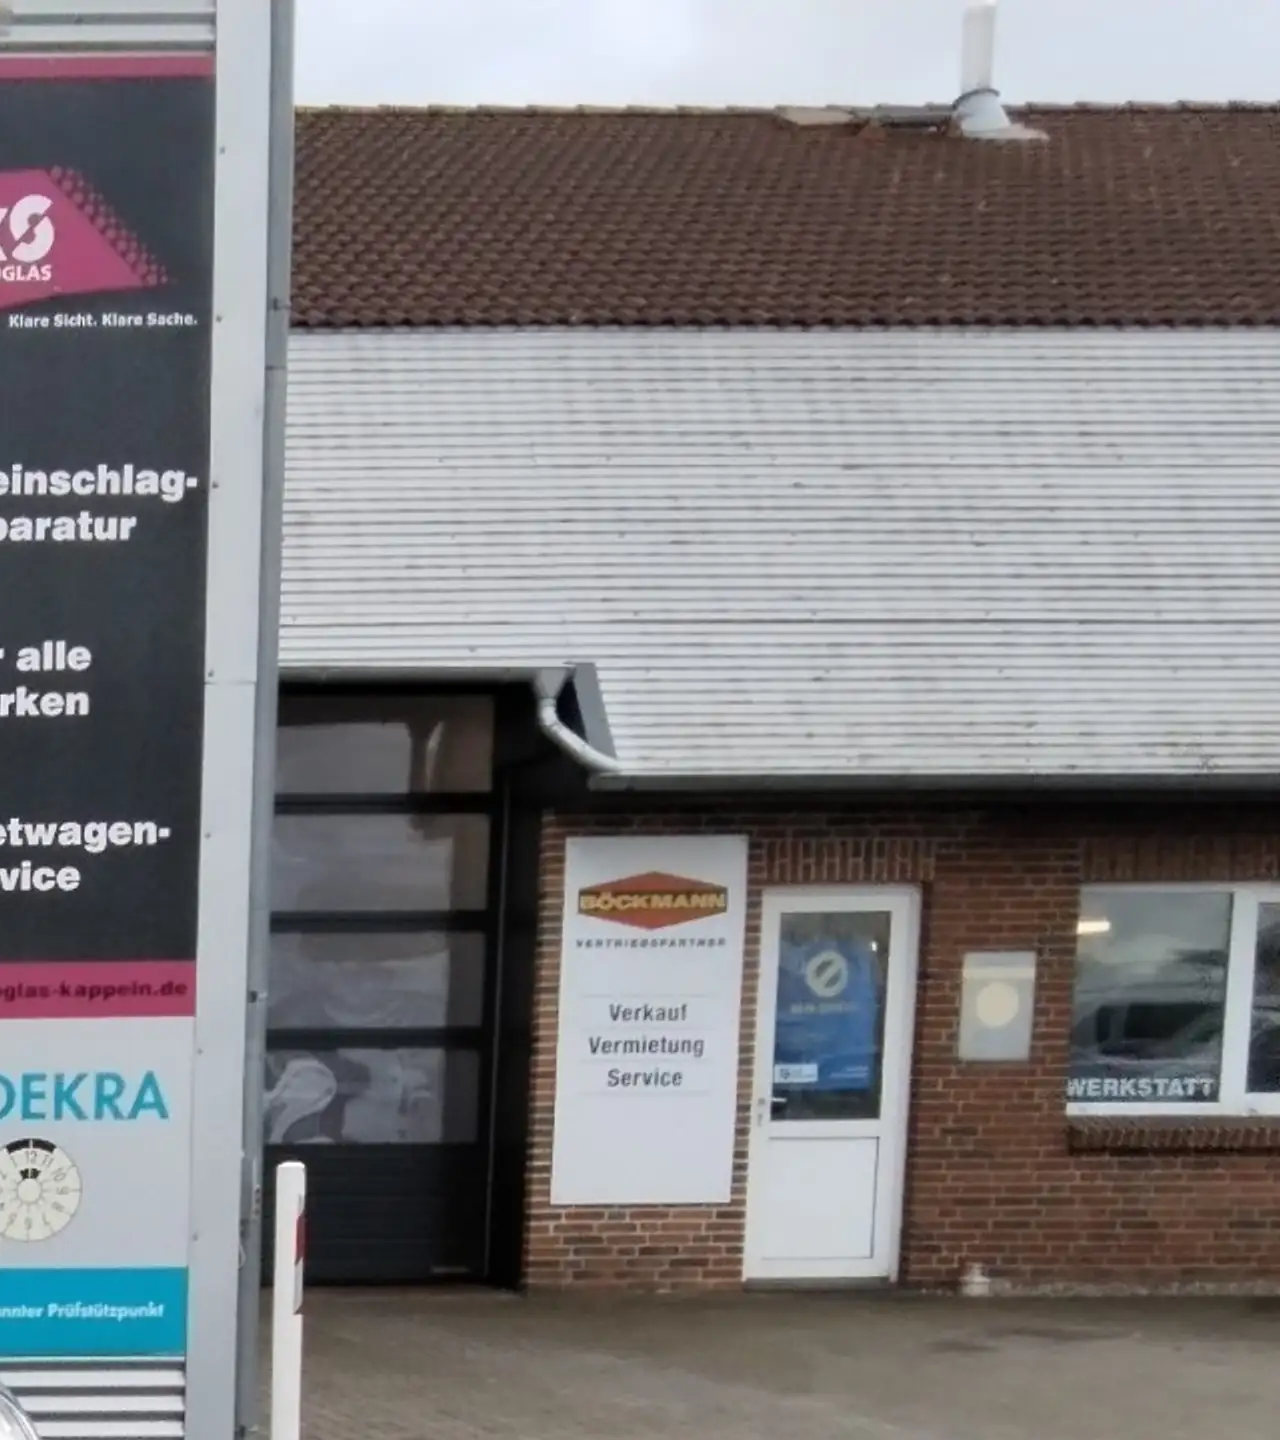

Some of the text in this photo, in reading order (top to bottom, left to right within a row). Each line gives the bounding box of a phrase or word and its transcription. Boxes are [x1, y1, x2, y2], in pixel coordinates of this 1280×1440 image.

[9, 312, 197, 328] Klare Sicht. Klare Sache.
[16, 641, 92, 672] alle
[580, 891, 726, 912] BÖCKMANN
[608, 1002, 687, 1022] Verkauf
[588, 1035, 705, 1058] Vermietung
[607, 1067, 683, 1087] Service
[1066, 1077, 1214, 1097] WERKSTATT
[48, 1301, 164, 1322] Prüfstützpunkt
